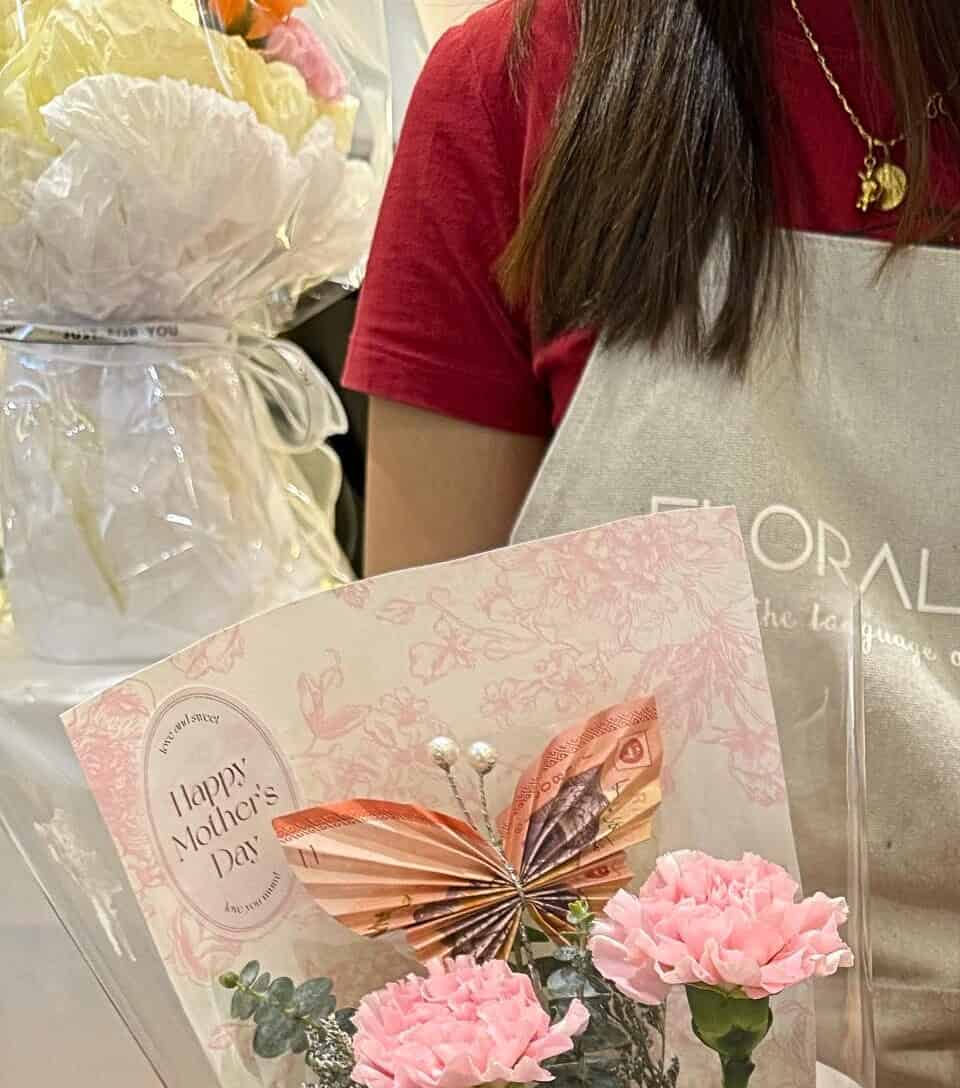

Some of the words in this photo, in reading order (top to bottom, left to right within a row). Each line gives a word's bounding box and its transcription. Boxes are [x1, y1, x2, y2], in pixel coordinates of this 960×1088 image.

[146, 325, 179, 338] YOU
[159, 730, 175, 754] love
[173, 713, 190, 734] and
[190, 712, 220, 725] sweet
[169, 757, 247, 817] Happy
[171, 783, 280, 863] Mother's
[210, 835, 260, 879] Day
